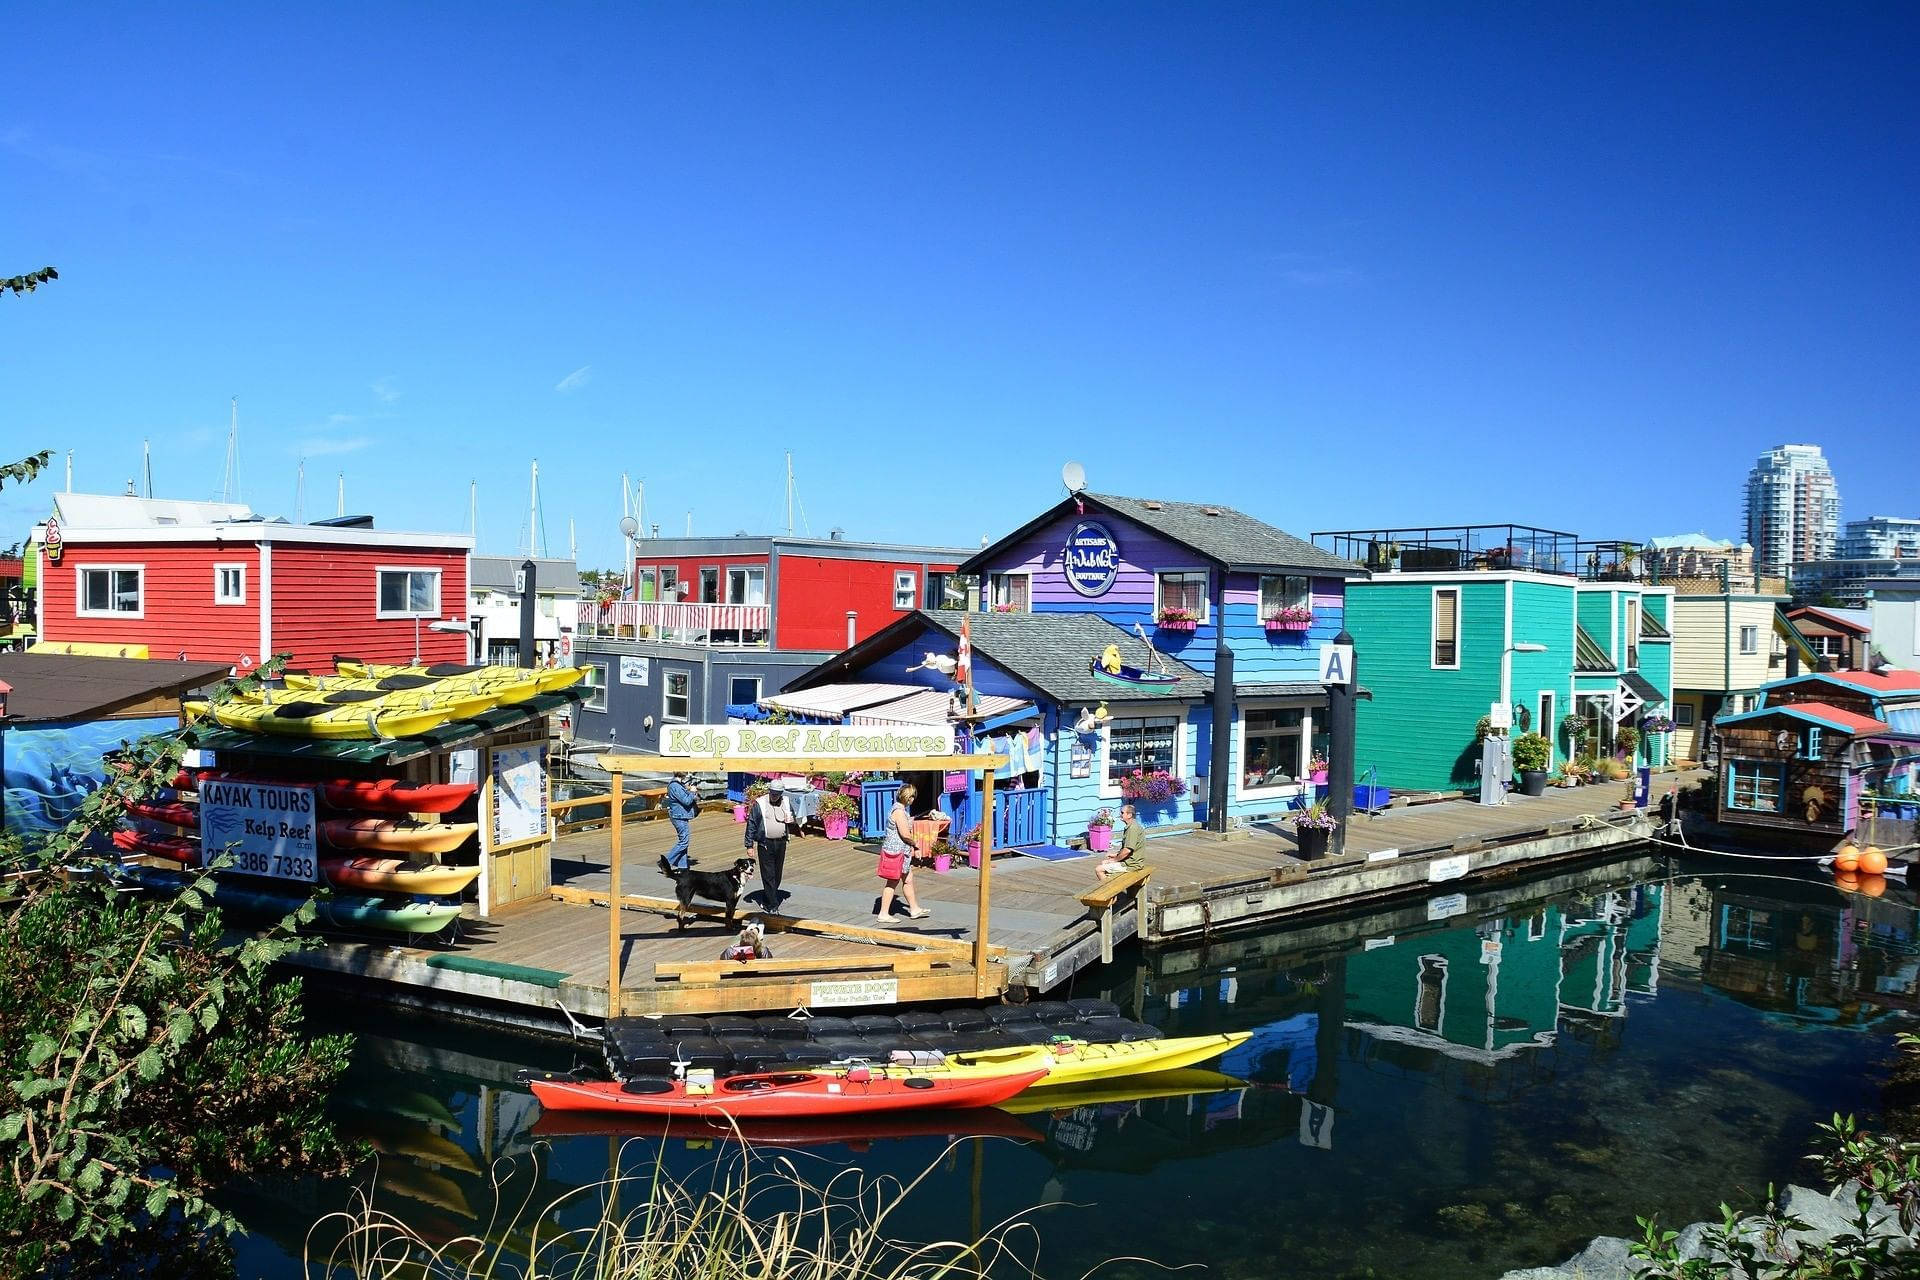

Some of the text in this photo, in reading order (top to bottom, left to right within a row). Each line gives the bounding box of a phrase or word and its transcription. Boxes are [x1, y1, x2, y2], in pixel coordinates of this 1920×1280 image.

[517, 574, 524, 591] B
[1325, 652, 1345, 681] A
[669, 728, 731, 757] Kelp
[738, 729, 800, 752] Reef
[803, 729, 946, 753] Adventures
[203, 783, 311, 813] KAYAK TOURS
[244, 818, 312, 841] Kelp Reef
[239, 851, 269, 873] 386
[273, 855, 313, 878] 7333
[813, 981, 896, 996] PRIVATE DOCK
